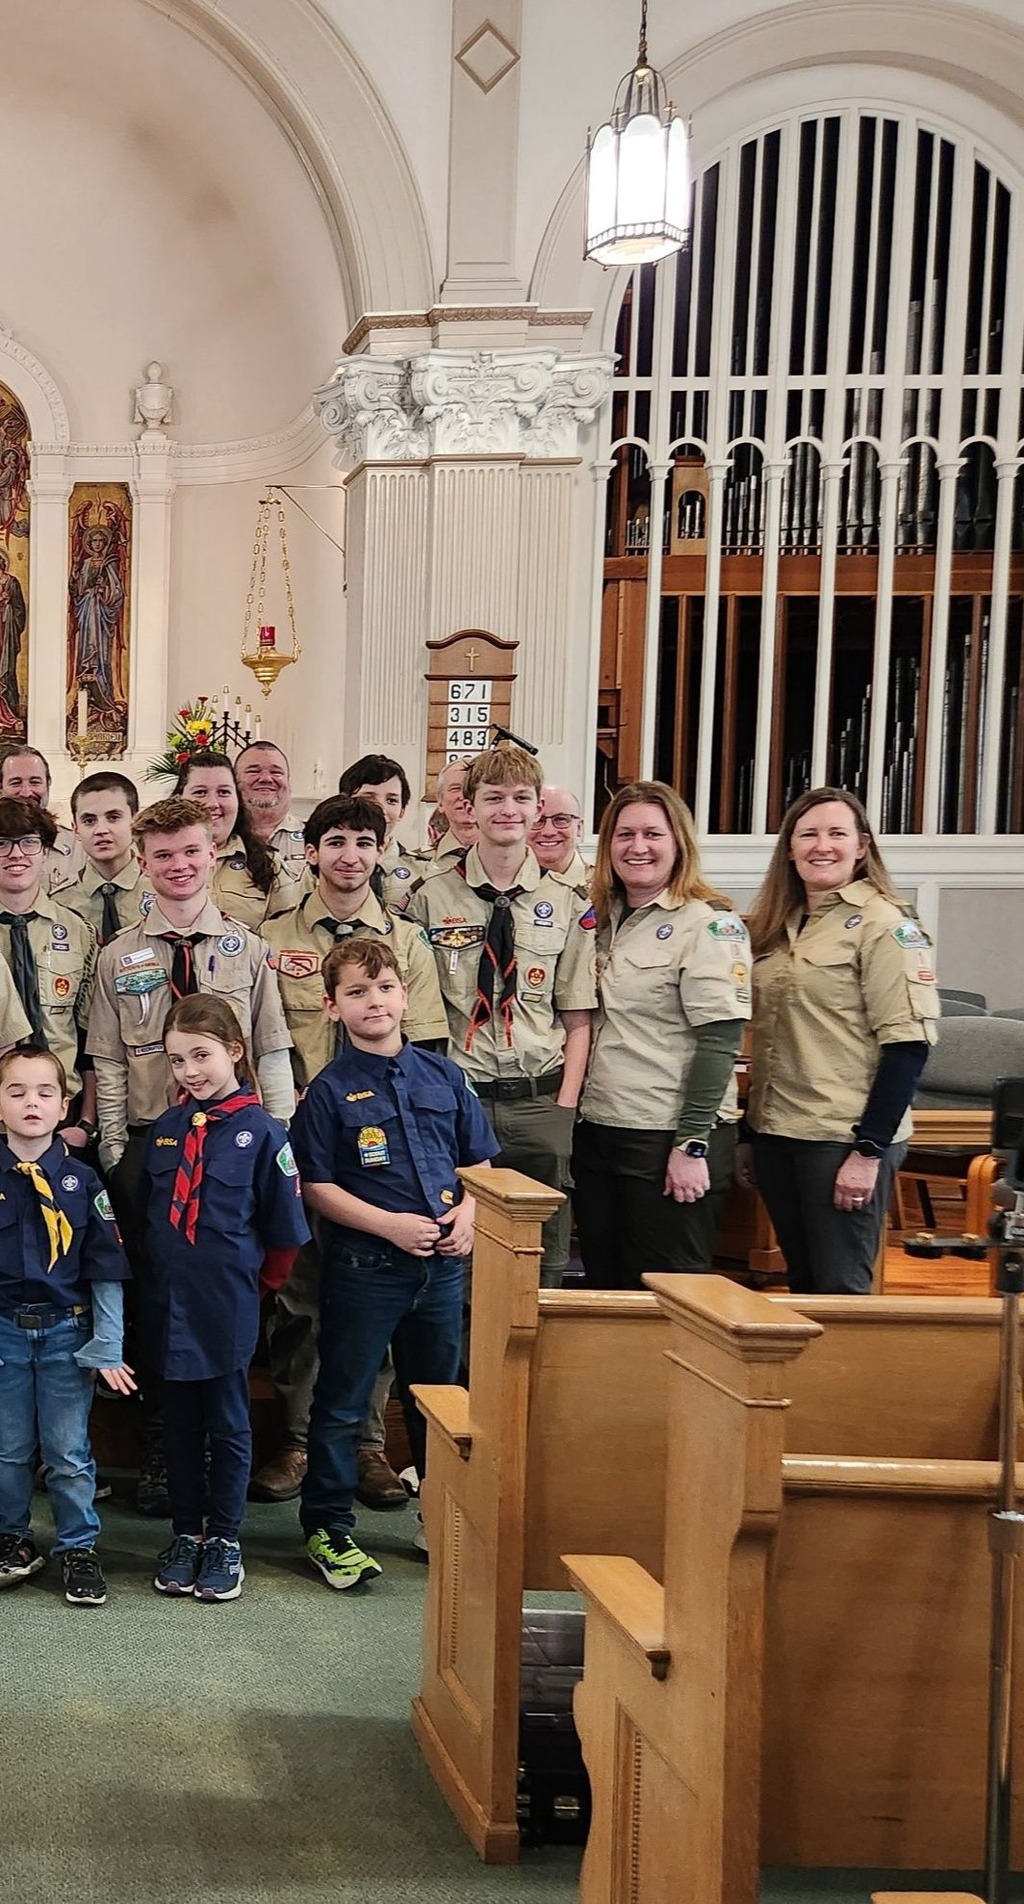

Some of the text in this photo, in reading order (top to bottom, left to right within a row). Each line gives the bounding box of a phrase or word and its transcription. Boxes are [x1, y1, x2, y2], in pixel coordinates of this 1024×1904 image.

[450, 684, 486, 699] 671
[450, 707, 488, 723] 315
[449, 731, 487, 746] 483
